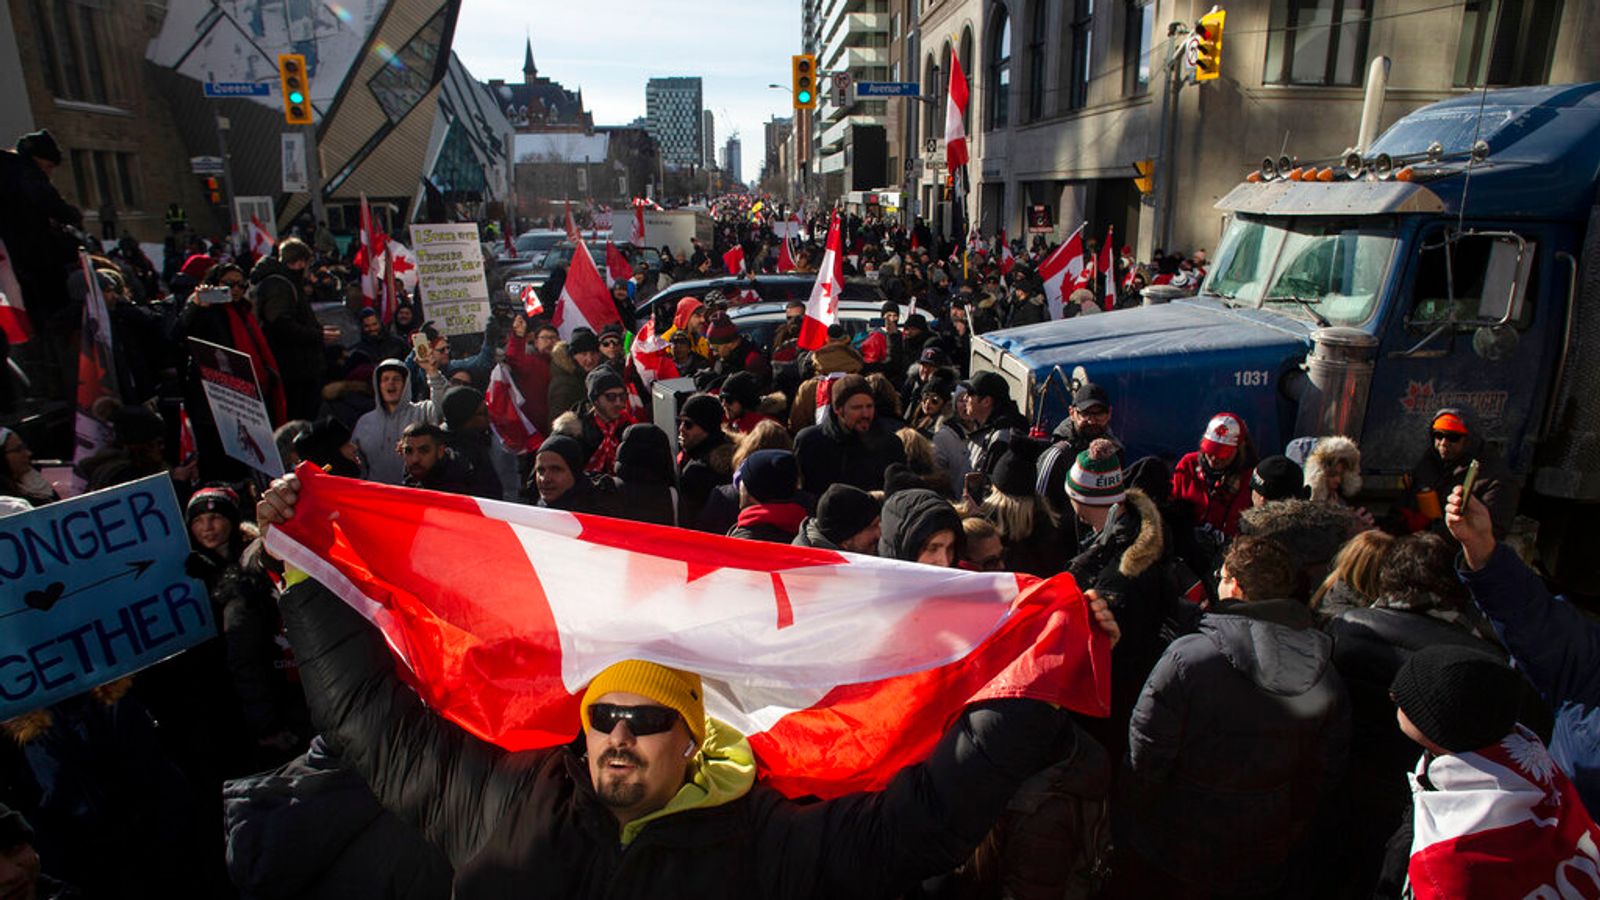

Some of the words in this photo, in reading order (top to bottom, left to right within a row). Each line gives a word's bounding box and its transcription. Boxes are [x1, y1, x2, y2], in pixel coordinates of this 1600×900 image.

[213, 82, 253, 94] Queens
[869, 83, 900, 93] Avenue
[1234, 370, 1269, 386] 1031
[0, 491, 170, 584] ONGER
